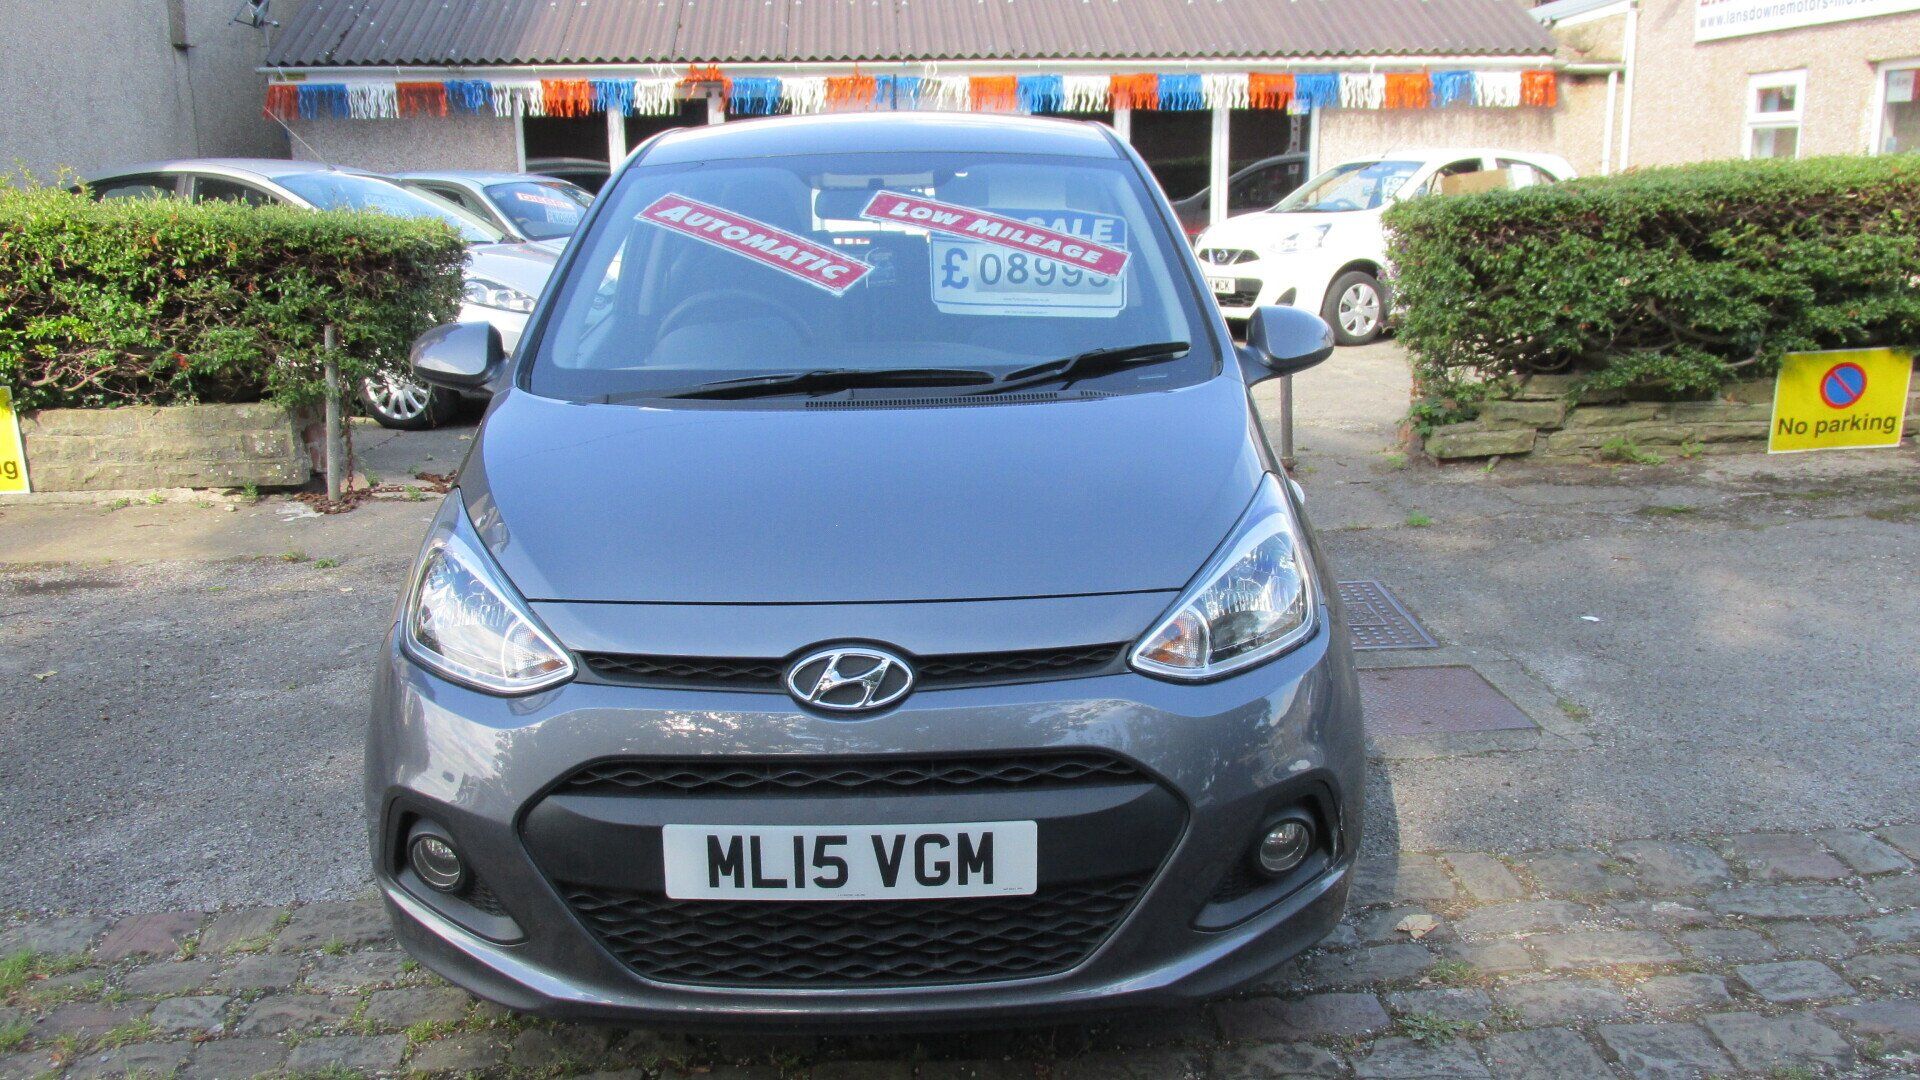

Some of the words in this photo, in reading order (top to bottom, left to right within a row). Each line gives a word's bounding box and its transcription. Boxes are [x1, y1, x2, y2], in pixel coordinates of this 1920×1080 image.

[653, 204, 850, 280] AUTOMATIC
[889, 202, 963, 224] LOW
[966, 218, 1104, 264] MILEAGE
[1777, 418, 1808, 435] No
[1814, 413, 1897, 438] parking
[706, 835, 849, 888] ML15
[871, 832, 994, 887] VGM
